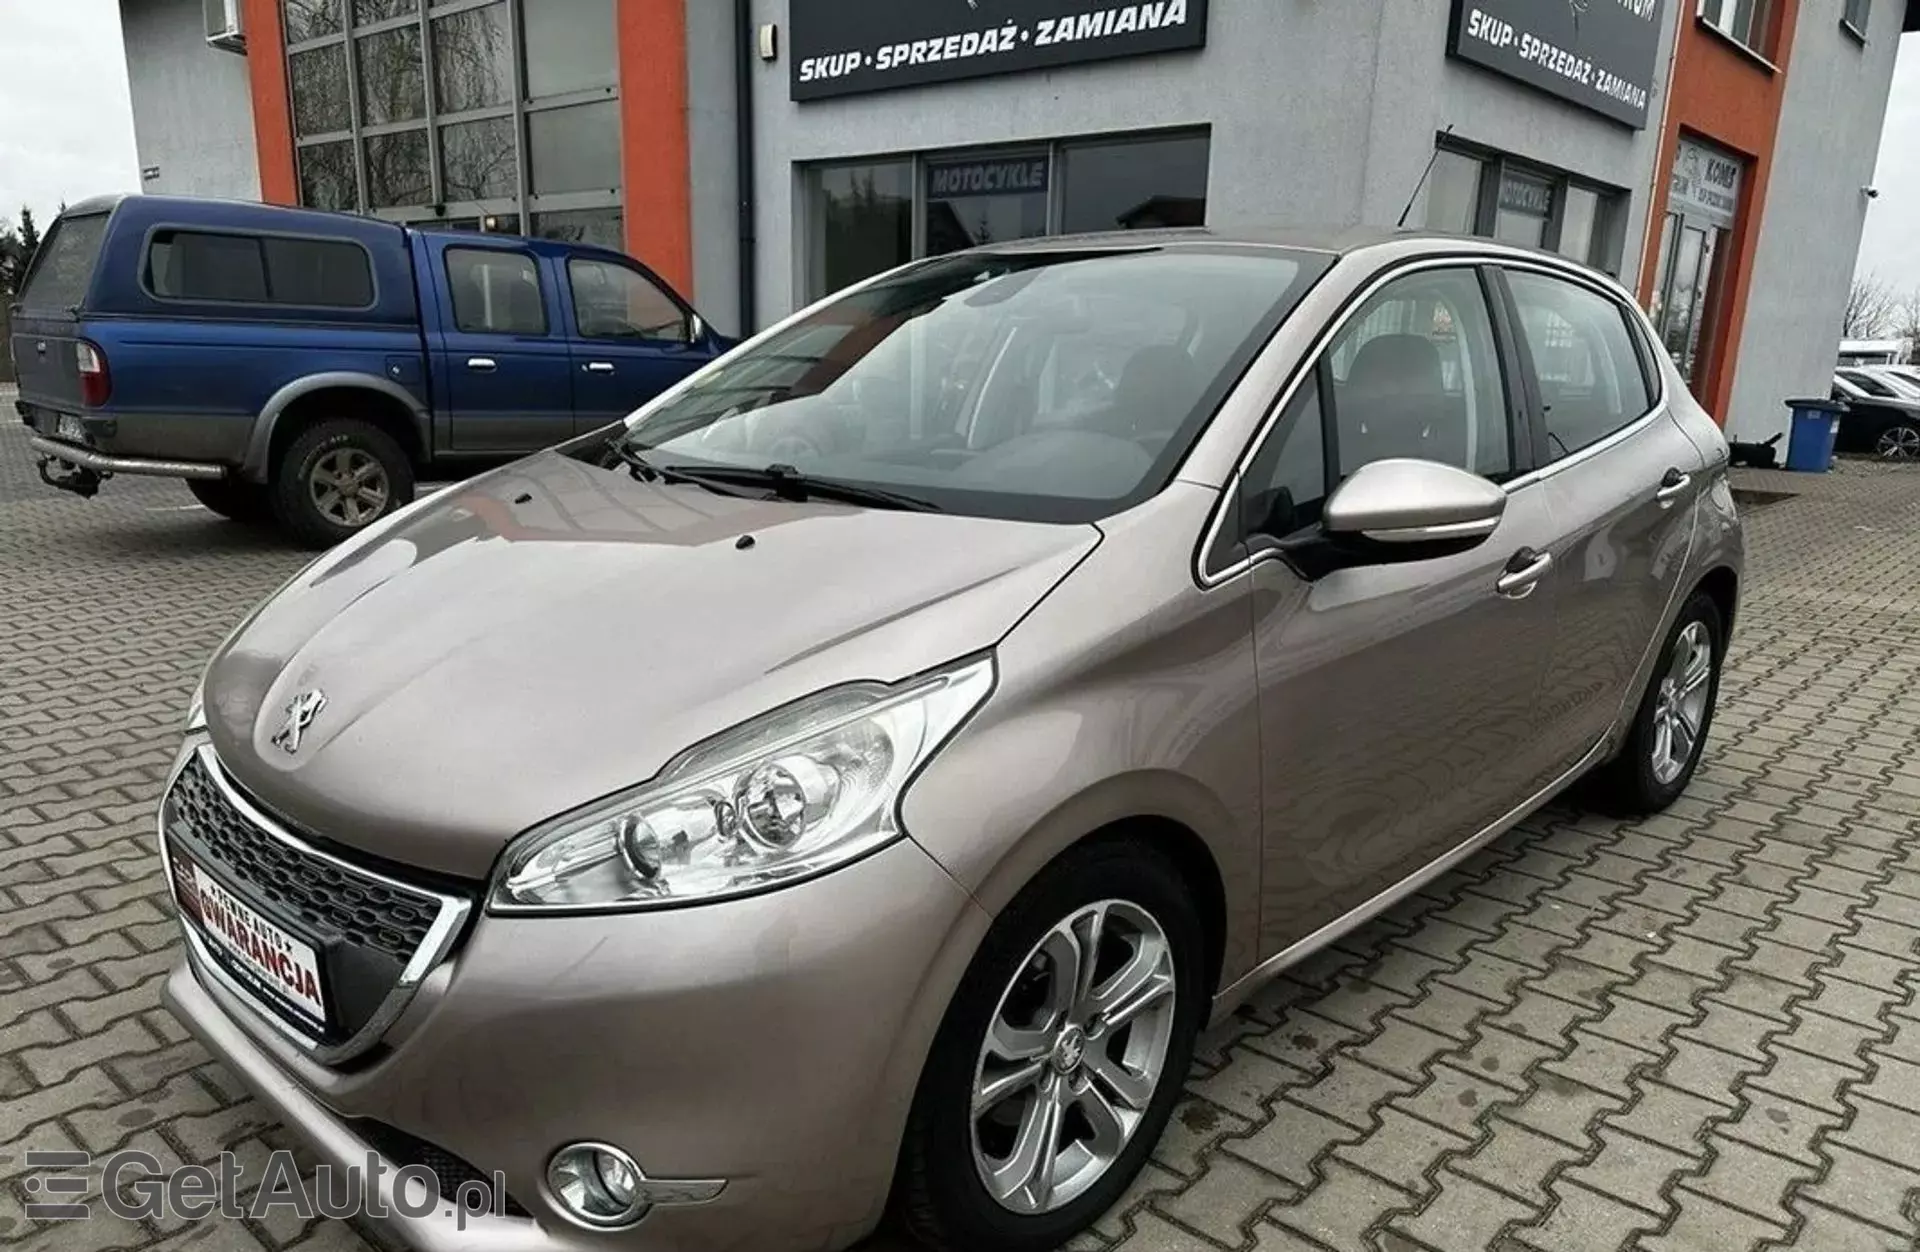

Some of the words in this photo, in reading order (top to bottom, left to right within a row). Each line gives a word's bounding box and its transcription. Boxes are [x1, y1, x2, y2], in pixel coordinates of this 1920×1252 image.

[799, 50, 860, 82] SKUP
[875, 19, 1018, 71] SPRZEDAŻ
[1035, 0, 1187, 47] ZAMIANA
[1467, 8, 1514, 48] SKUP
[1518, 33, 1592, 86] SPRZEDAŻ
[1595, 69, 1646, 110] ZAMIANA
[932, 161, 1044, 193] MOTOCYKLE
[200, 888, 321, 1006] GWARANCJA
